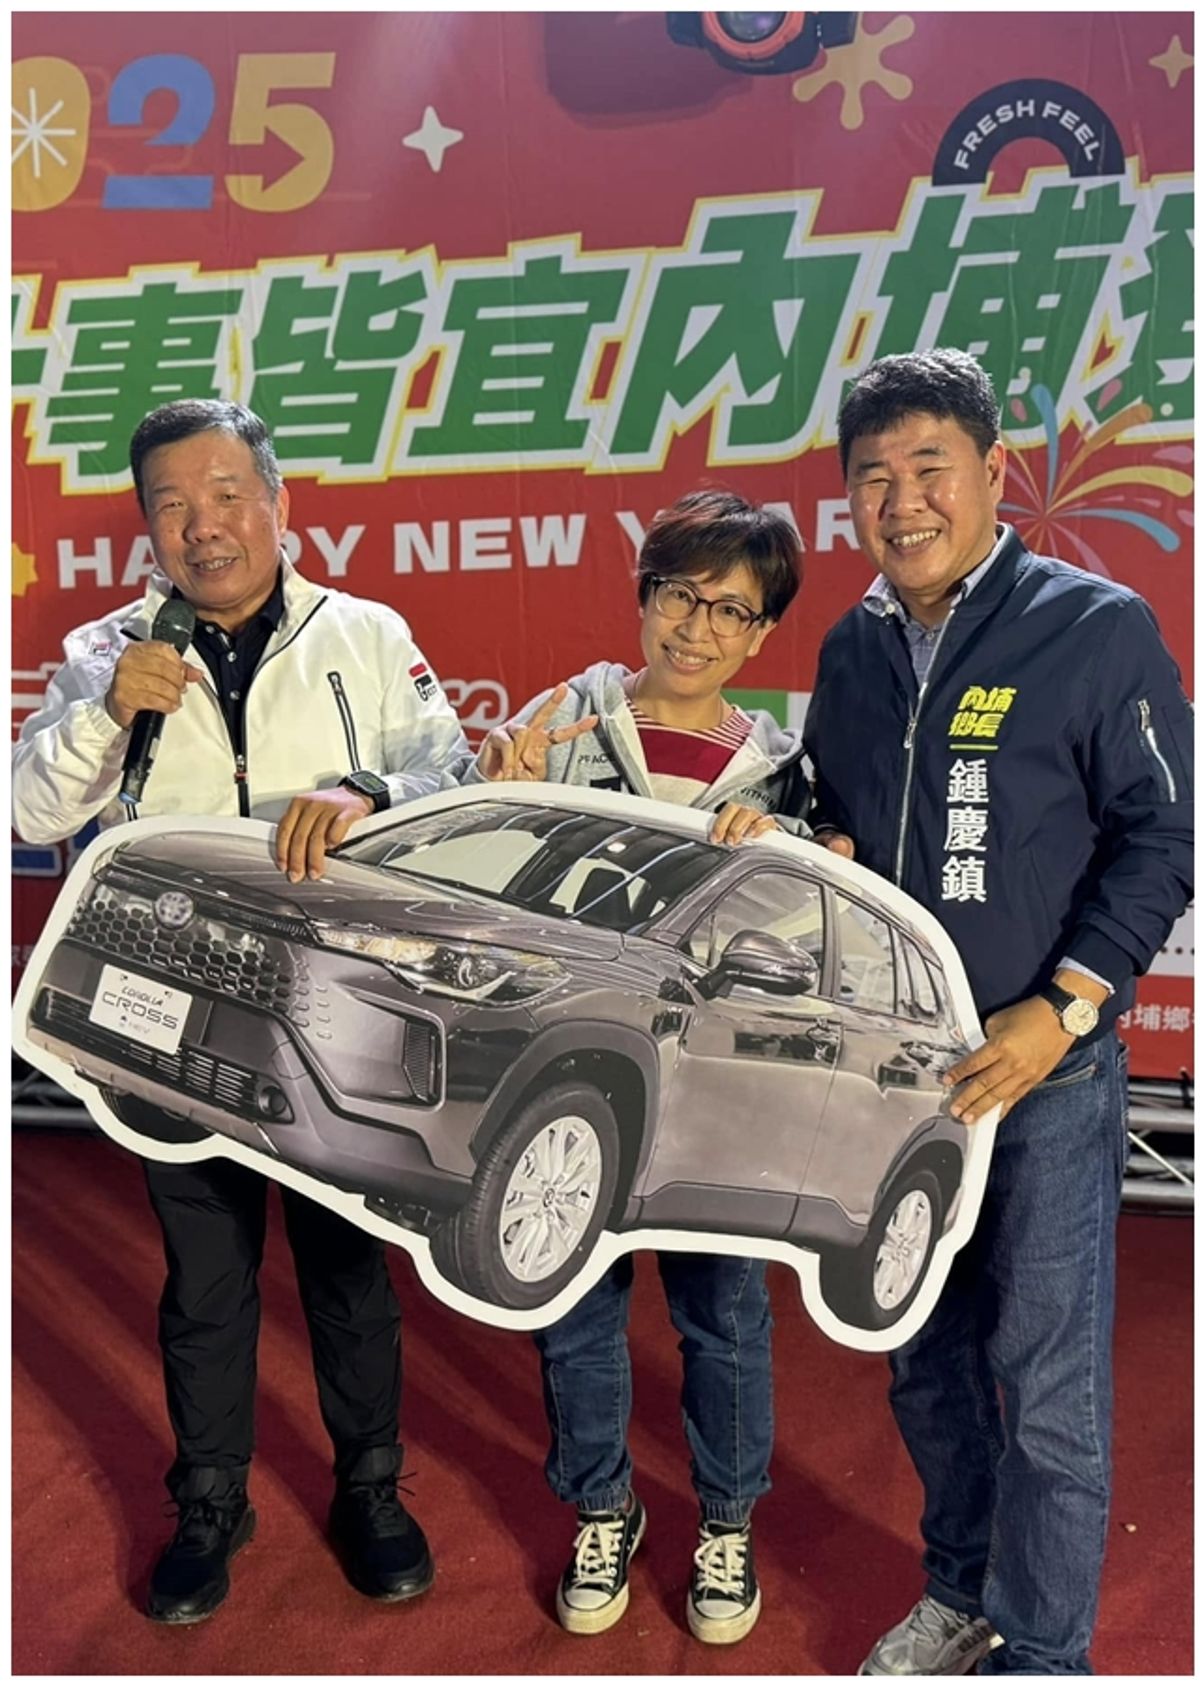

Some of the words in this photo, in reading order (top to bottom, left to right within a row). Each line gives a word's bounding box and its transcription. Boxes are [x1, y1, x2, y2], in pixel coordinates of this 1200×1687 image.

[953, 99, 1035, 170] FRESH
[1041, 101, 1100, 161] FEEL
[57, 524, 366, 589] HAY
[393, 513, 587, 575] NEW
[615, 498, 861, 562] YAR
[941, 758, 990, 903] 鍾慶鎮
[102, 991, 179, 1030] CROSS
